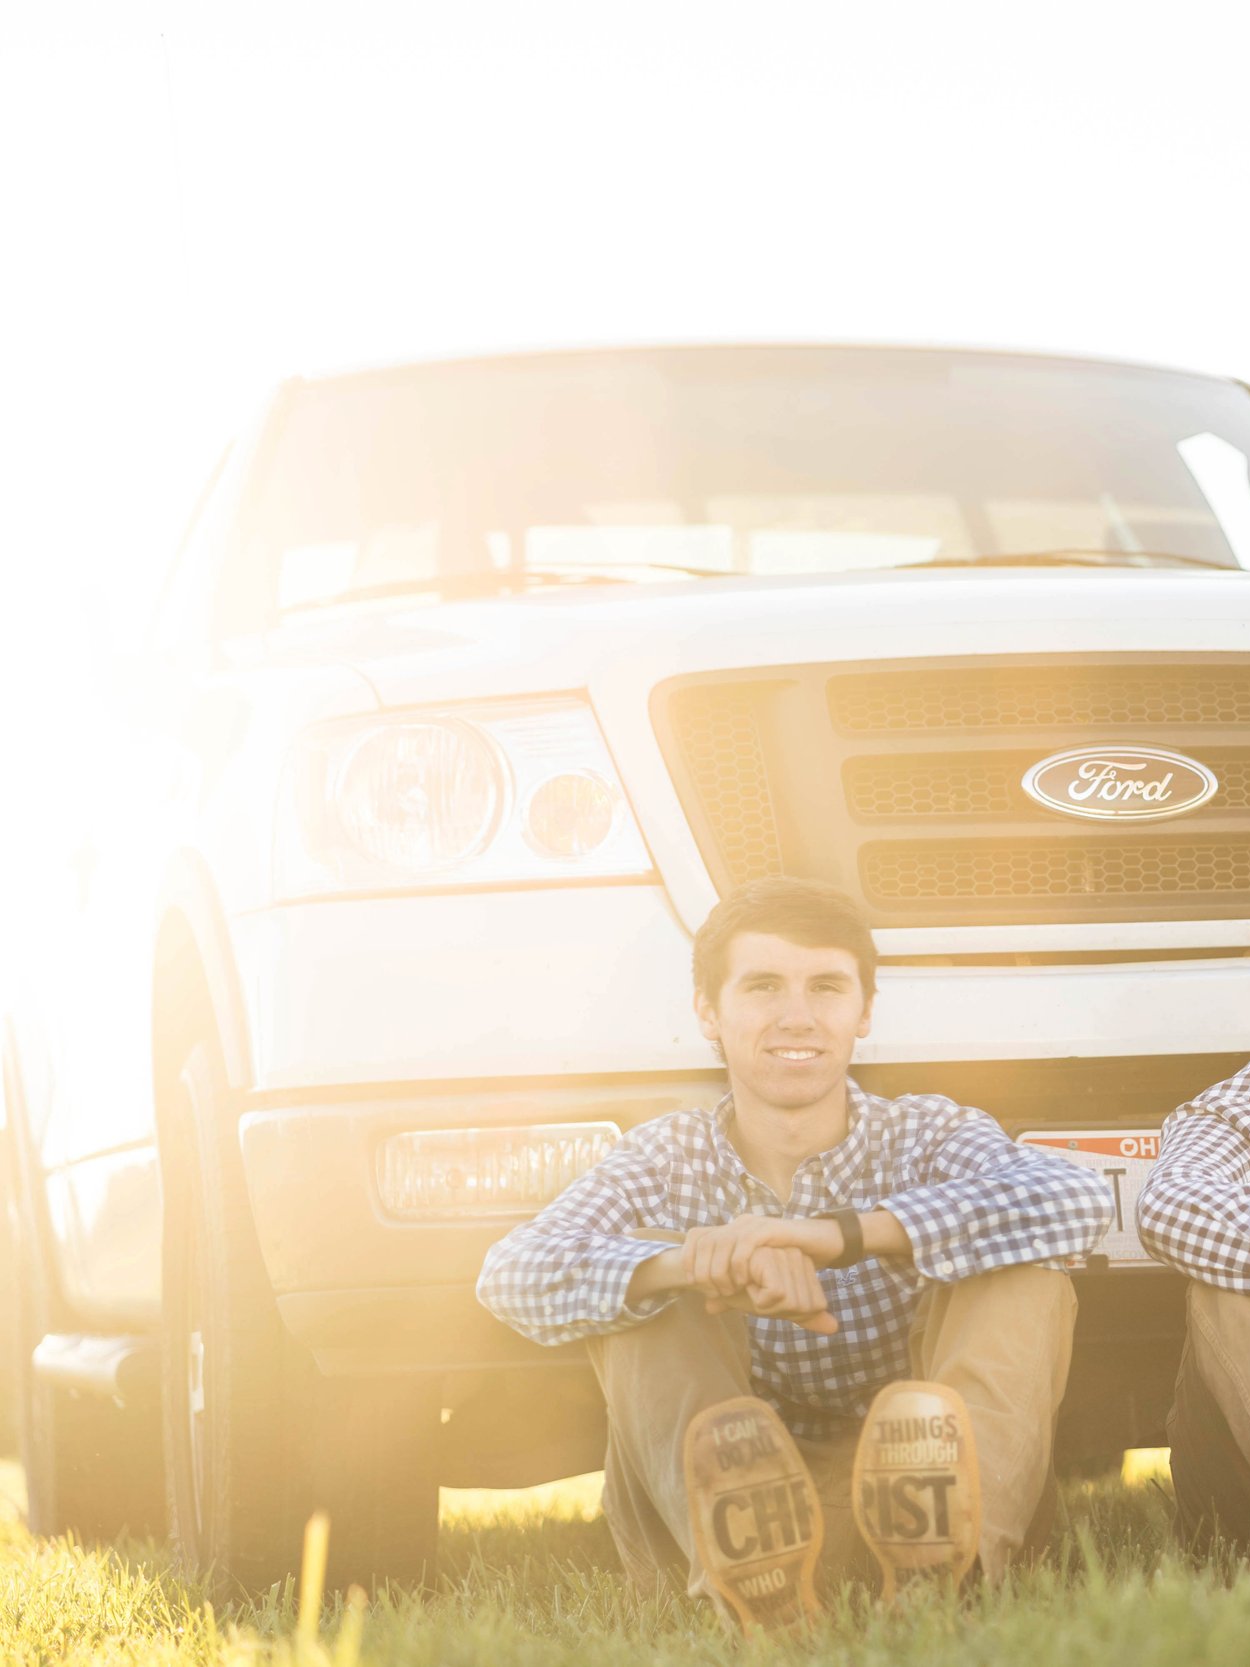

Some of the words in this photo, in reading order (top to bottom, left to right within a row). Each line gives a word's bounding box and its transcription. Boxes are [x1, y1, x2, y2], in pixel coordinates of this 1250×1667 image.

[1068, 761, 1173, 801] Ford
[712, 1427, 722, 1447] I
[724, 1417, 759, 1443] CAN
[876, 1413, 958, 1444] THINGS
[877, 1441, 959, 1465] THROUGH
[737, 1568, 787, 1598] WHO
